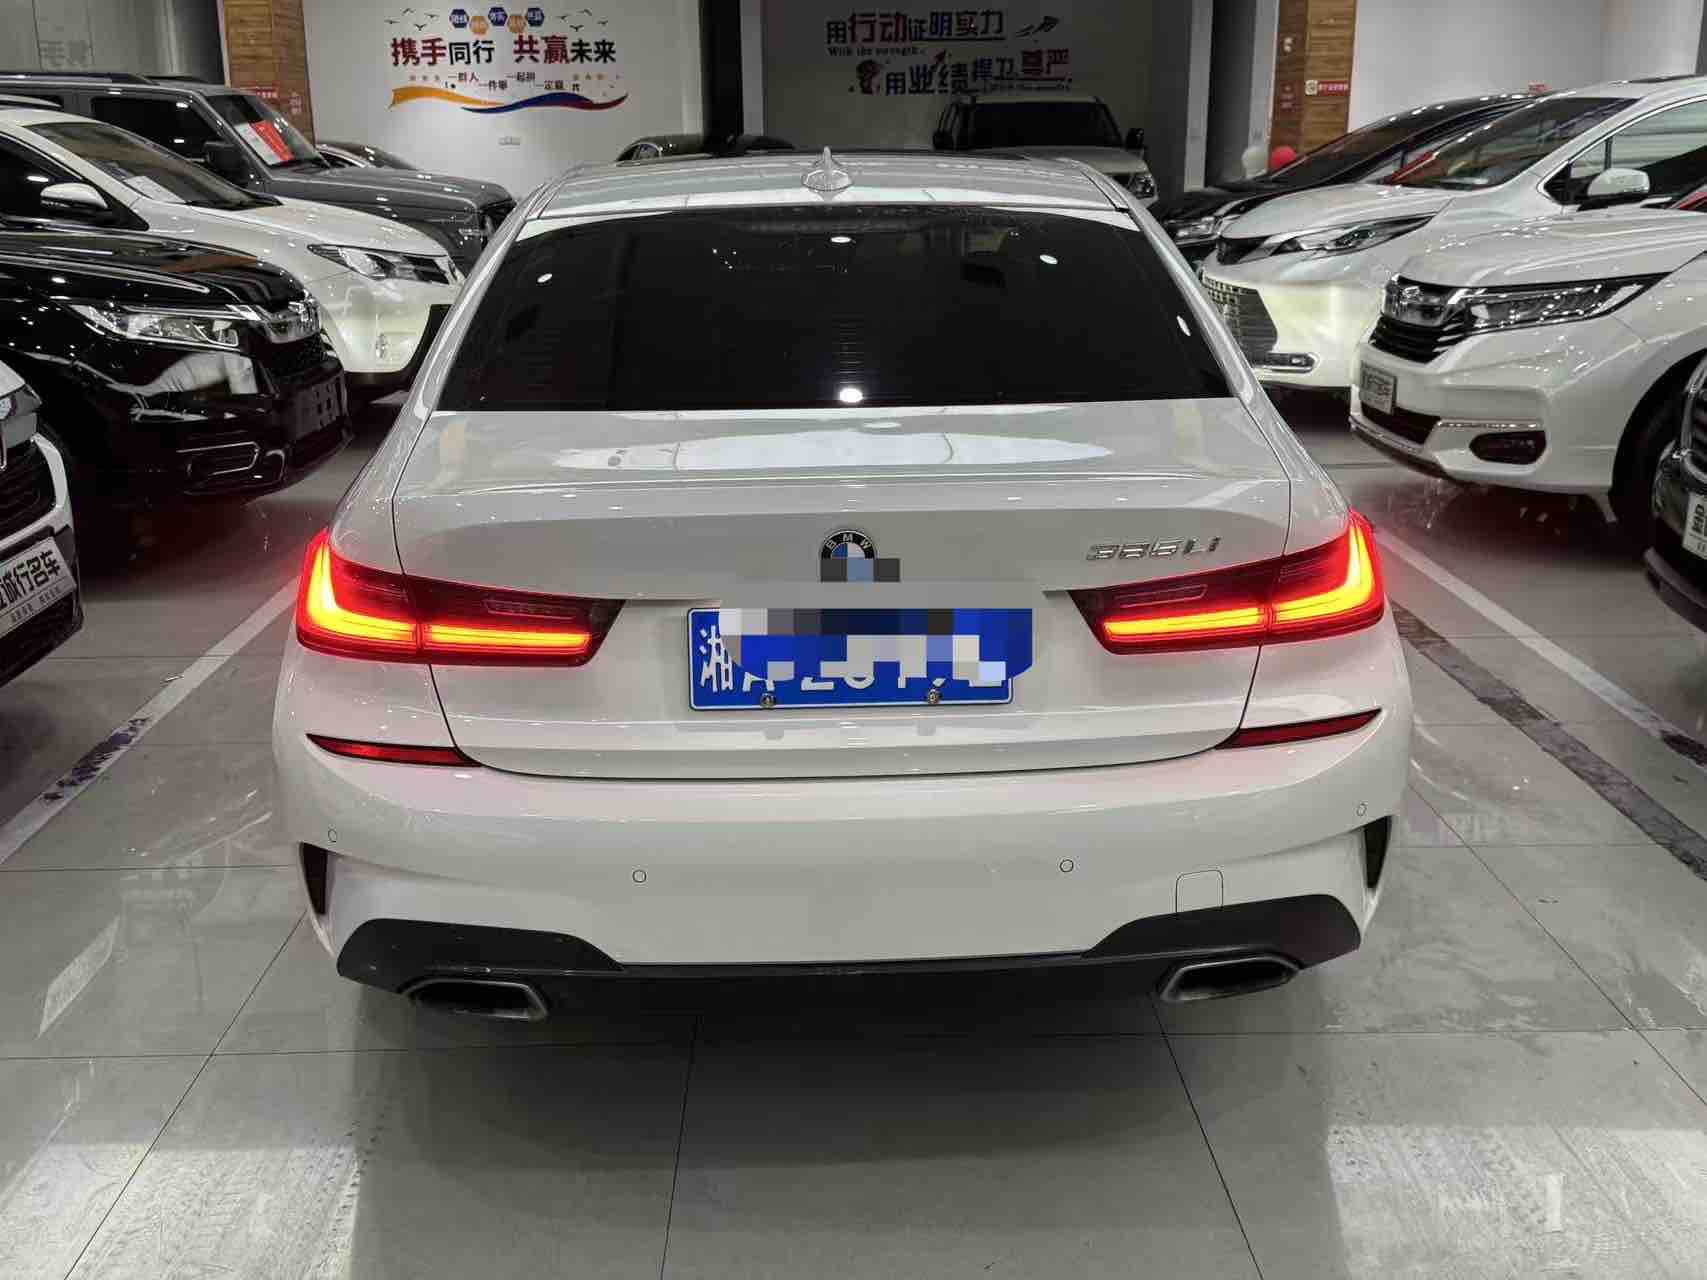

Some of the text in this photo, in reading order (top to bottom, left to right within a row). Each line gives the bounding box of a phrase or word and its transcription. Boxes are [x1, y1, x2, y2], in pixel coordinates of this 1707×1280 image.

[826, 10, 1004, 44] 用行动证明实力
[391, 35, 616, 67] 携手同行 共赢未来
[825, 533, 872, 551] BMW
